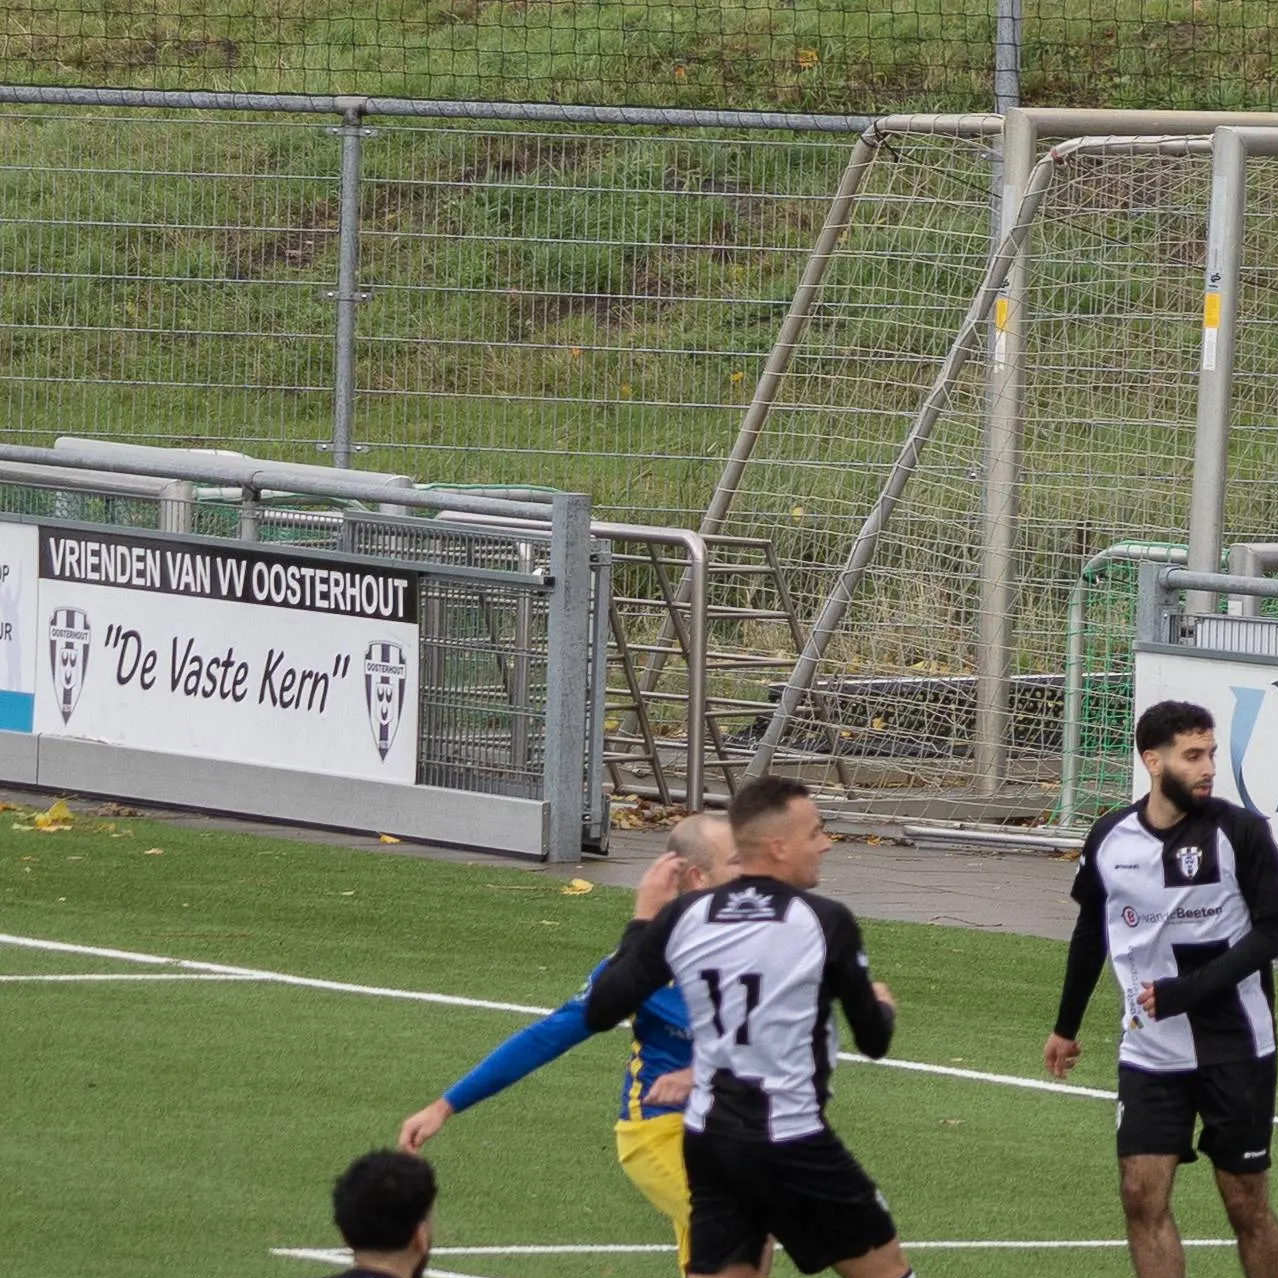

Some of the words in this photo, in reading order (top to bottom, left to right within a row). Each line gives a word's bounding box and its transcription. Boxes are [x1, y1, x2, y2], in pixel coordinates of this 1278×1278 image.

[50, 537, 160, 588] VRIENDEN
[167, 551, 210, 593] VAN
[216, 557, 246, 597] VV
[253, 562, 407, 617] OOSTERHOUT
[52, 627, 88, 641] OOSTERHOUT
[105, 624, 157, 690] "De
[171, 636, 249, 702] Vaste
[258, 649, 350, 713] Kern"
[367, 662, 404, 675] OOSTERHOUT
[699, 968, 762, 1045] 11
